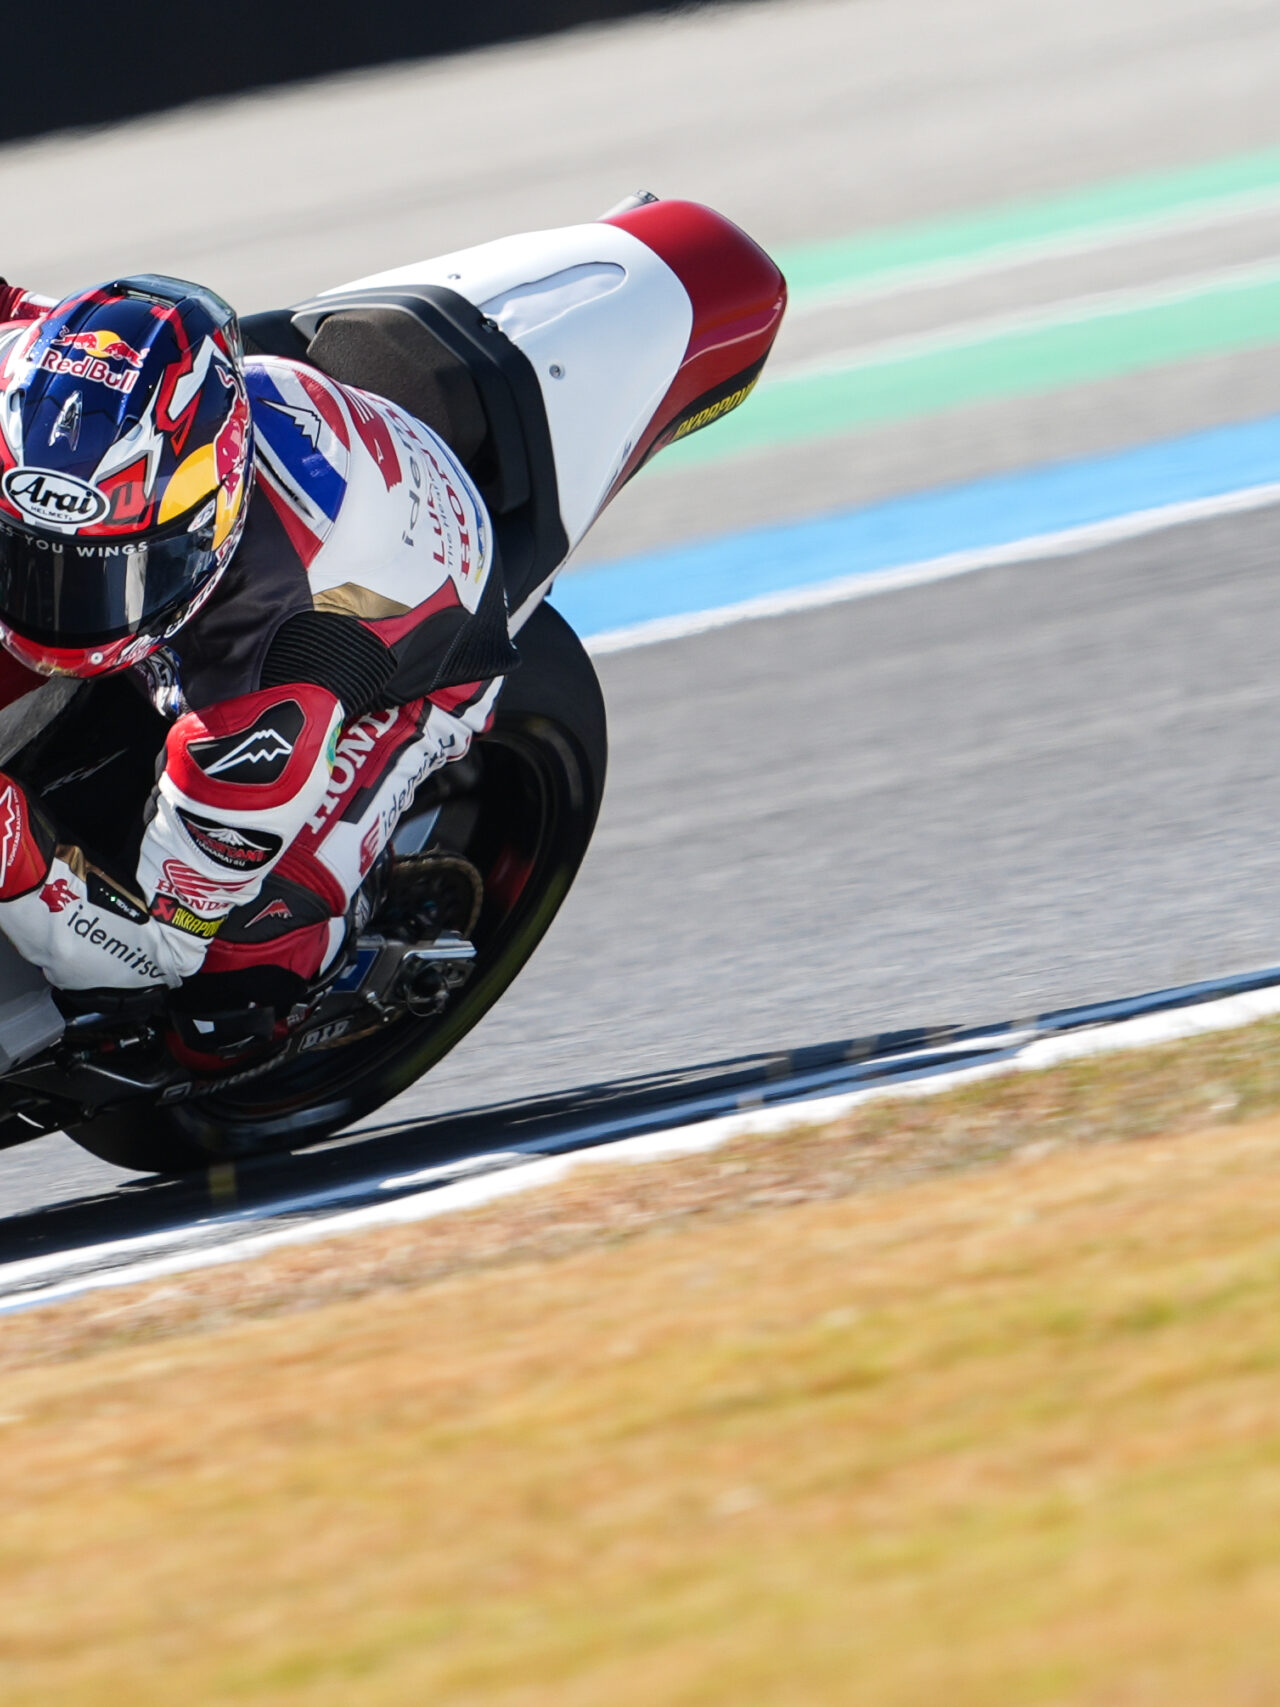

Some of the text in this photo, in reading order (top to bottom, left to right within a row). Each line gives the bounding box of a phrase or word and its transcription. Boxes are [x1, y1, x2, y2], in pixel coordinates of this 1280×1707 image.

[10, 476, 94, 515] Arai
[24, 535, 65, 555] YOU
[76, 541, 150, 558] WINGS
[305, 705, 400, 835] HOND
[66, 903, 167, 980] idemitsu
